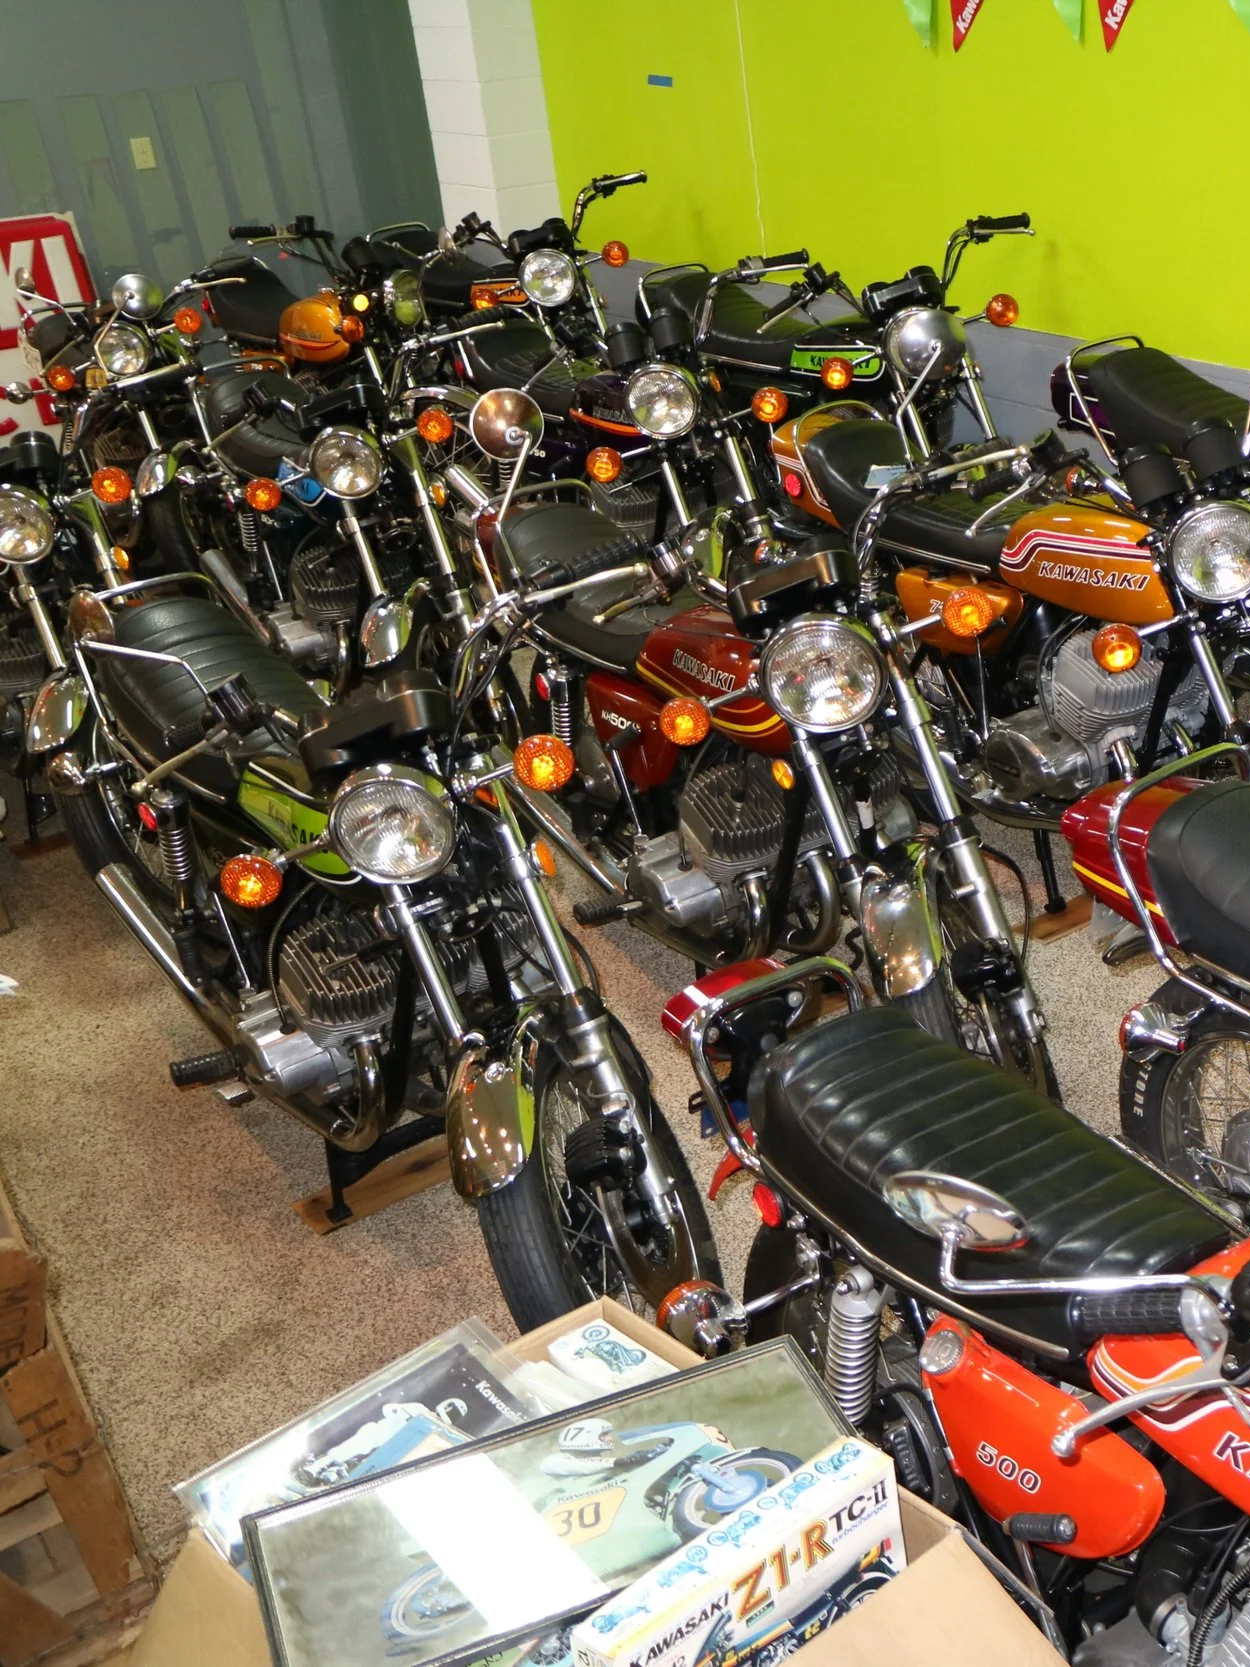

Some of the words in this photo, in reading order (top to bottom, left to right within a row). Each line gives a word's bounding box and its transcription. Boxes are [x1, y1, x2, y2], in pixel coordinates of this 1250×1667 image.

[1038, 560, 1151, 591] KAWASAKI
[672, 649, 736, 692] KAWASAKI
[601, 709, 641, 732] KH50
[976, 1440, 1042, 1494] 500
[628, 1592, 729, 1667] KAWASAKI
